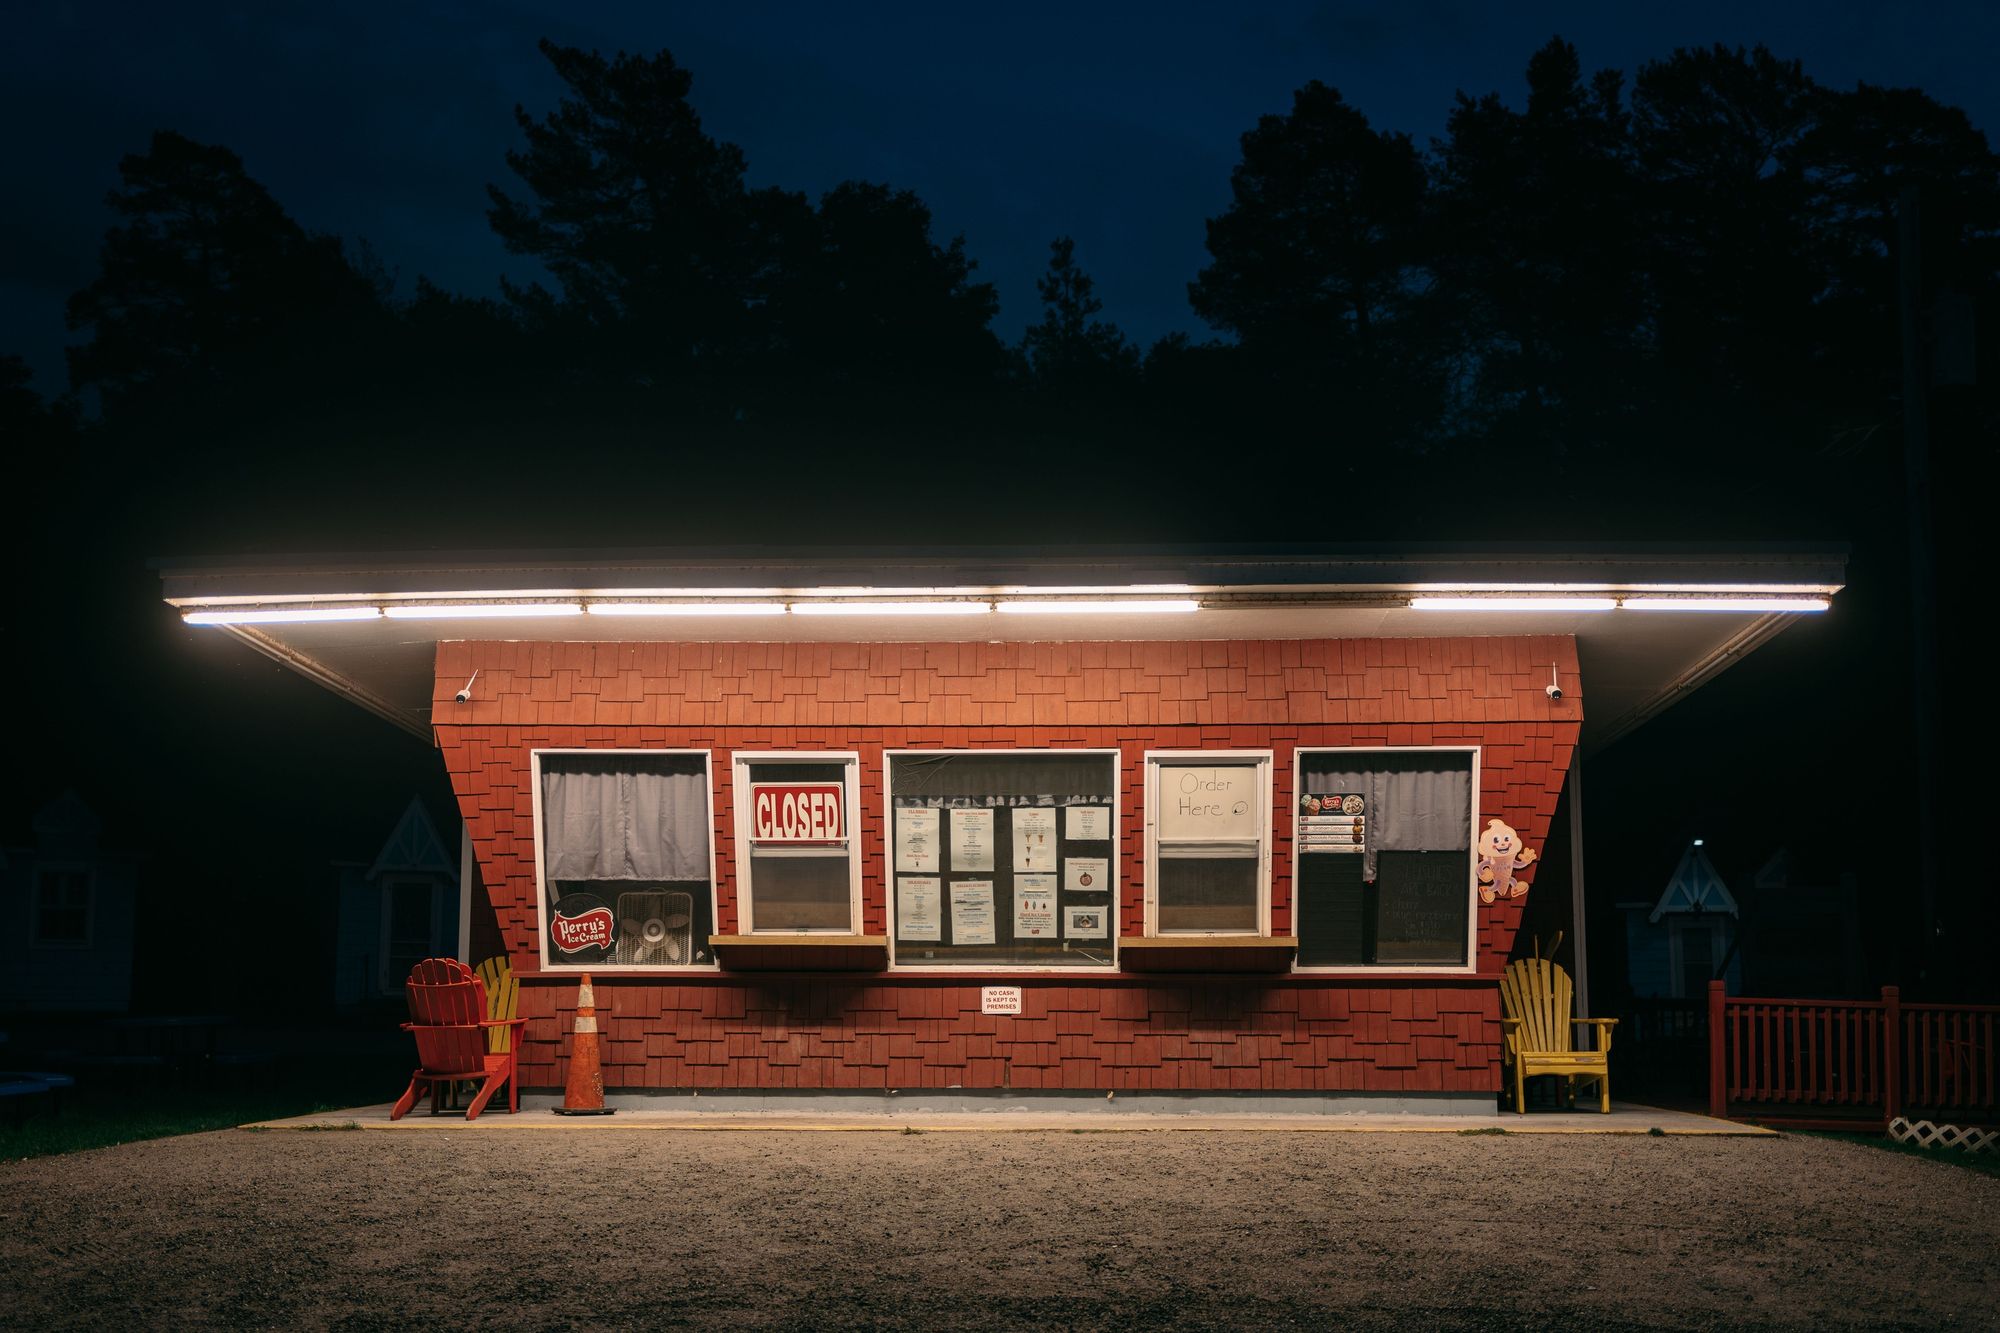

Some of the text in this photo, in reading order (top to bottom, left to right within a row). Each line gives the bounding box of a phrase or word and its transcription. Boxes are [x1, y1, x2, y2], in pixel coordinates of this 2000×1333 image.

[1180, 769, 1232, 794] Order
[757, 792, 839, 839] CLOSED
[1179, 797, 1223, 816] Here
[558, 918, 605, 940] Perry's
[567, 932, 605, 943] Ice Cream
